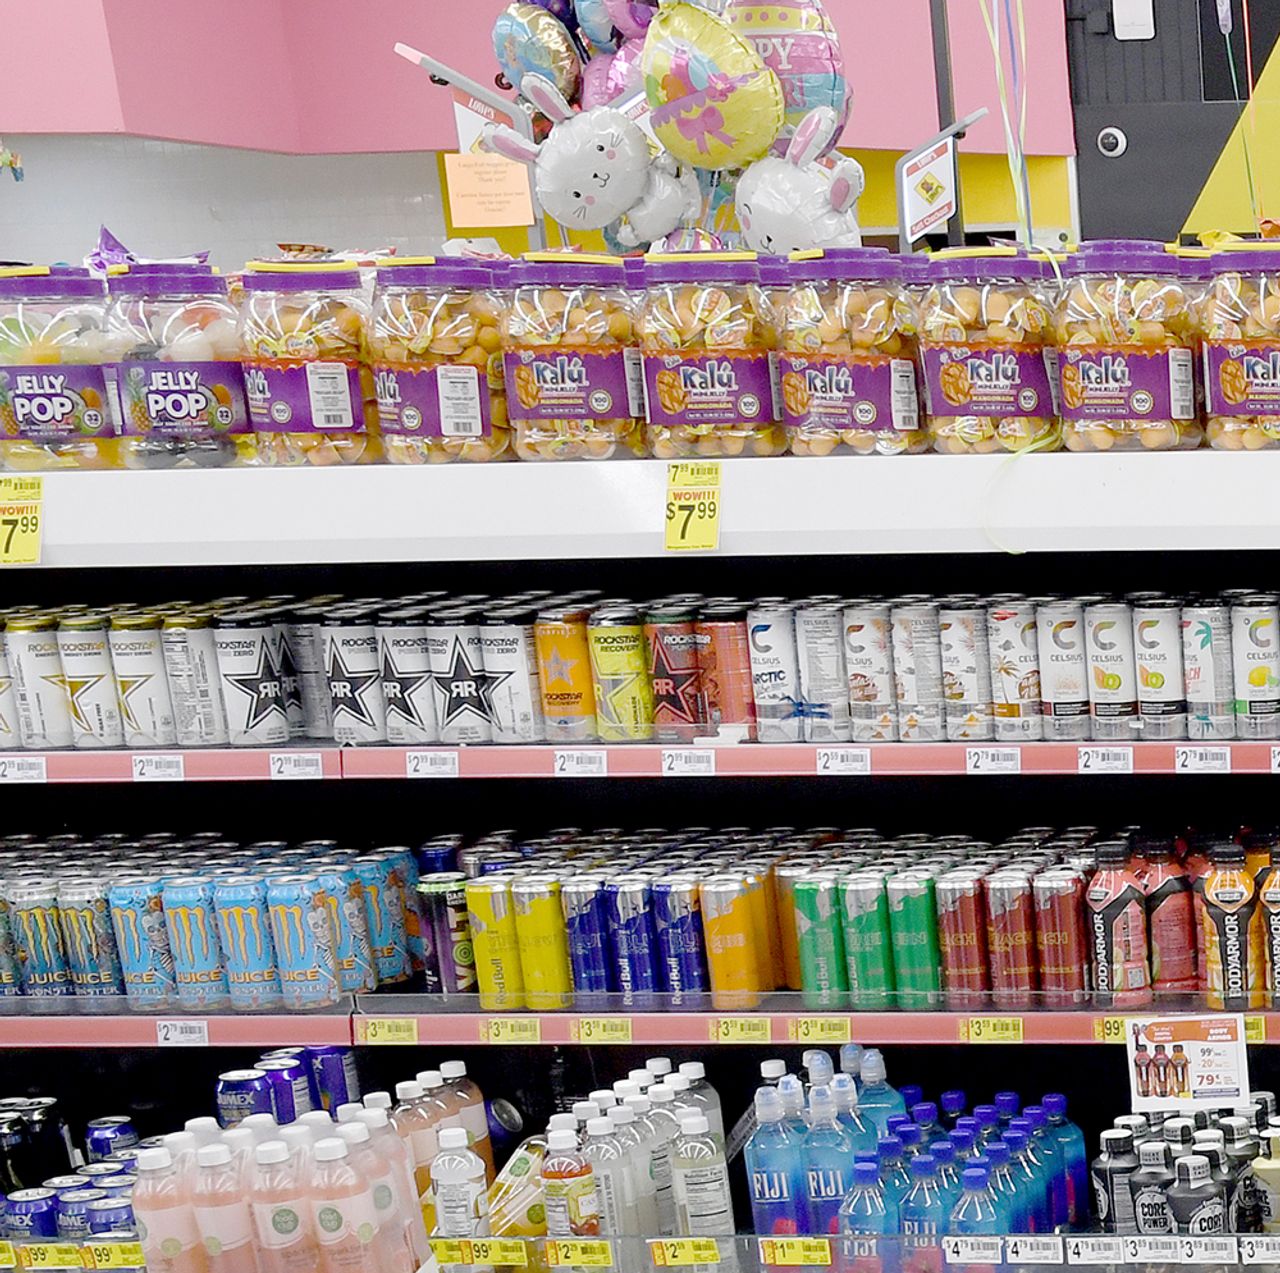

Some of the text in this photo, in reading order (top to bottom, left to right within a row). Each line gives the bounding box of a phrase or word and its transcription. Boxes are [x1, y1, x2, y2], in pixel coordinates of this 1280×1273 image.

[15, 375, 65, 394] JELLY
[149, 371, 200, 390] JELLY
[14, 396, 74, 422] POP
[147, 392, 207, 418] POP
[672, 491, 716, 502] WOW!!!
[1228, 914, 1239, 998] BODYARMOR
[753, 1170, 789, 1199] FIJI
[807, 1169, 845, 1197] FIJI
[1141, 1202, 1167, 1217] CORE
